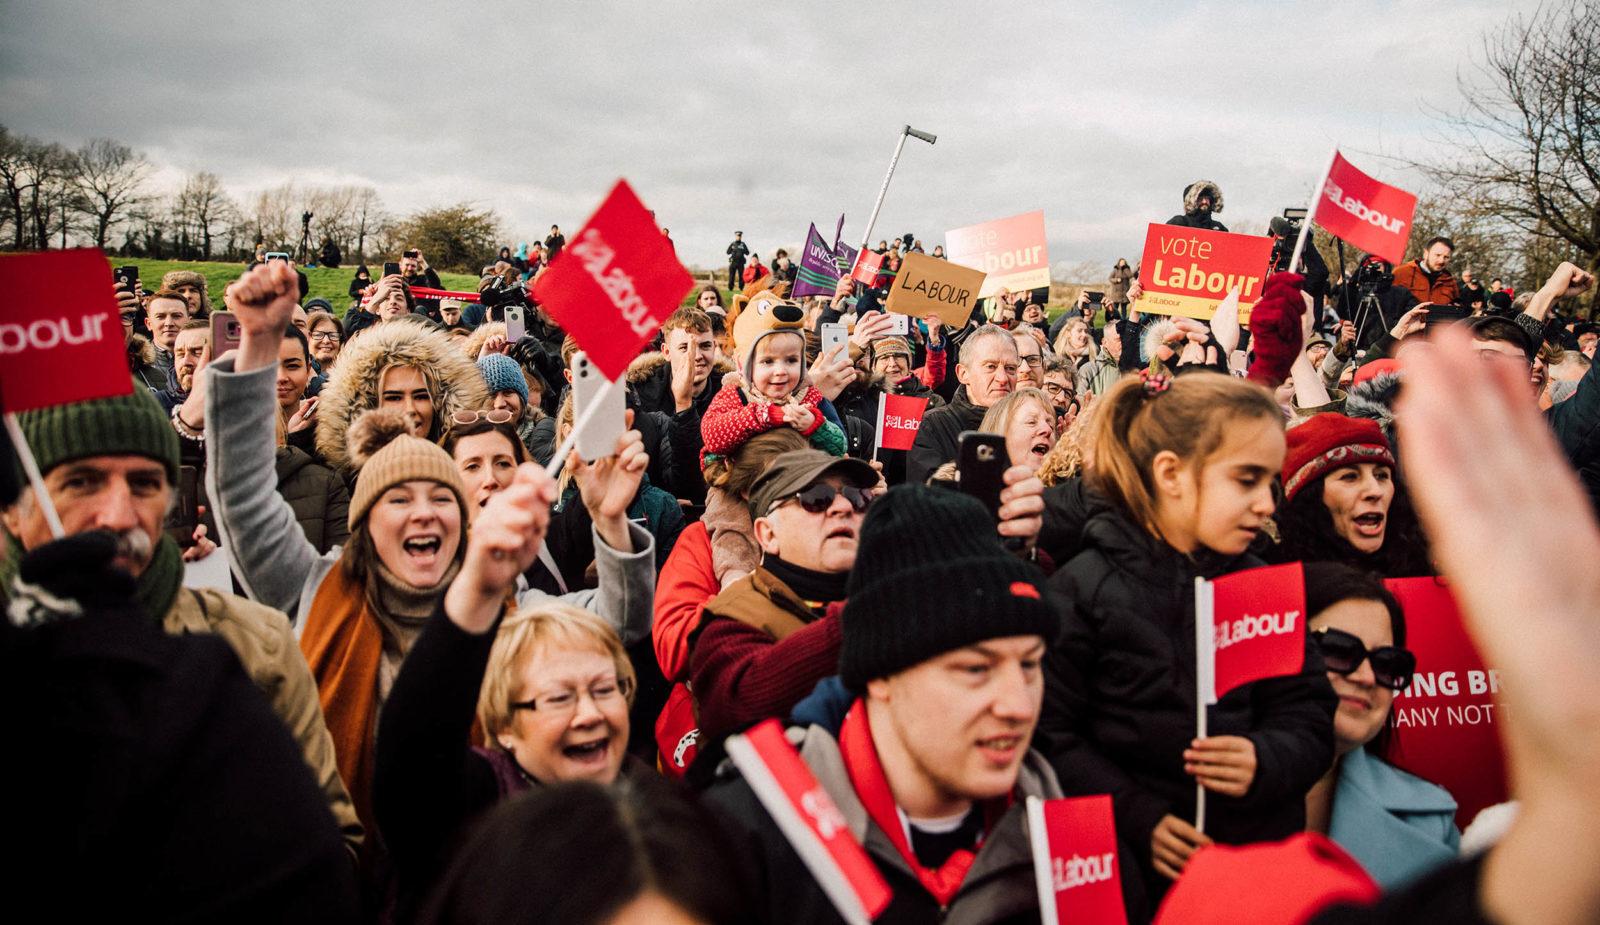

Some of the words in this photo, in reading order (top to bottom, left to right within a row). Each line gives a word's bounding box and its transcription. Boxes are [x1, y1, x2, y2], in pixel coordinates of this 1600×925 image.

[1334, 187, 1406, 235] Labour
[1160, 235, 1213, 260] vote
[901, 271, 970, 307] LABOUR
[1152, 259, 1260, 297] Labour
[897, 416, 921, 430] Lab
[1219, 610, 1300, 649] Labour
[1392, 706, 1440, 728] ANY
[1446, 704, 1494, 726] NOT
